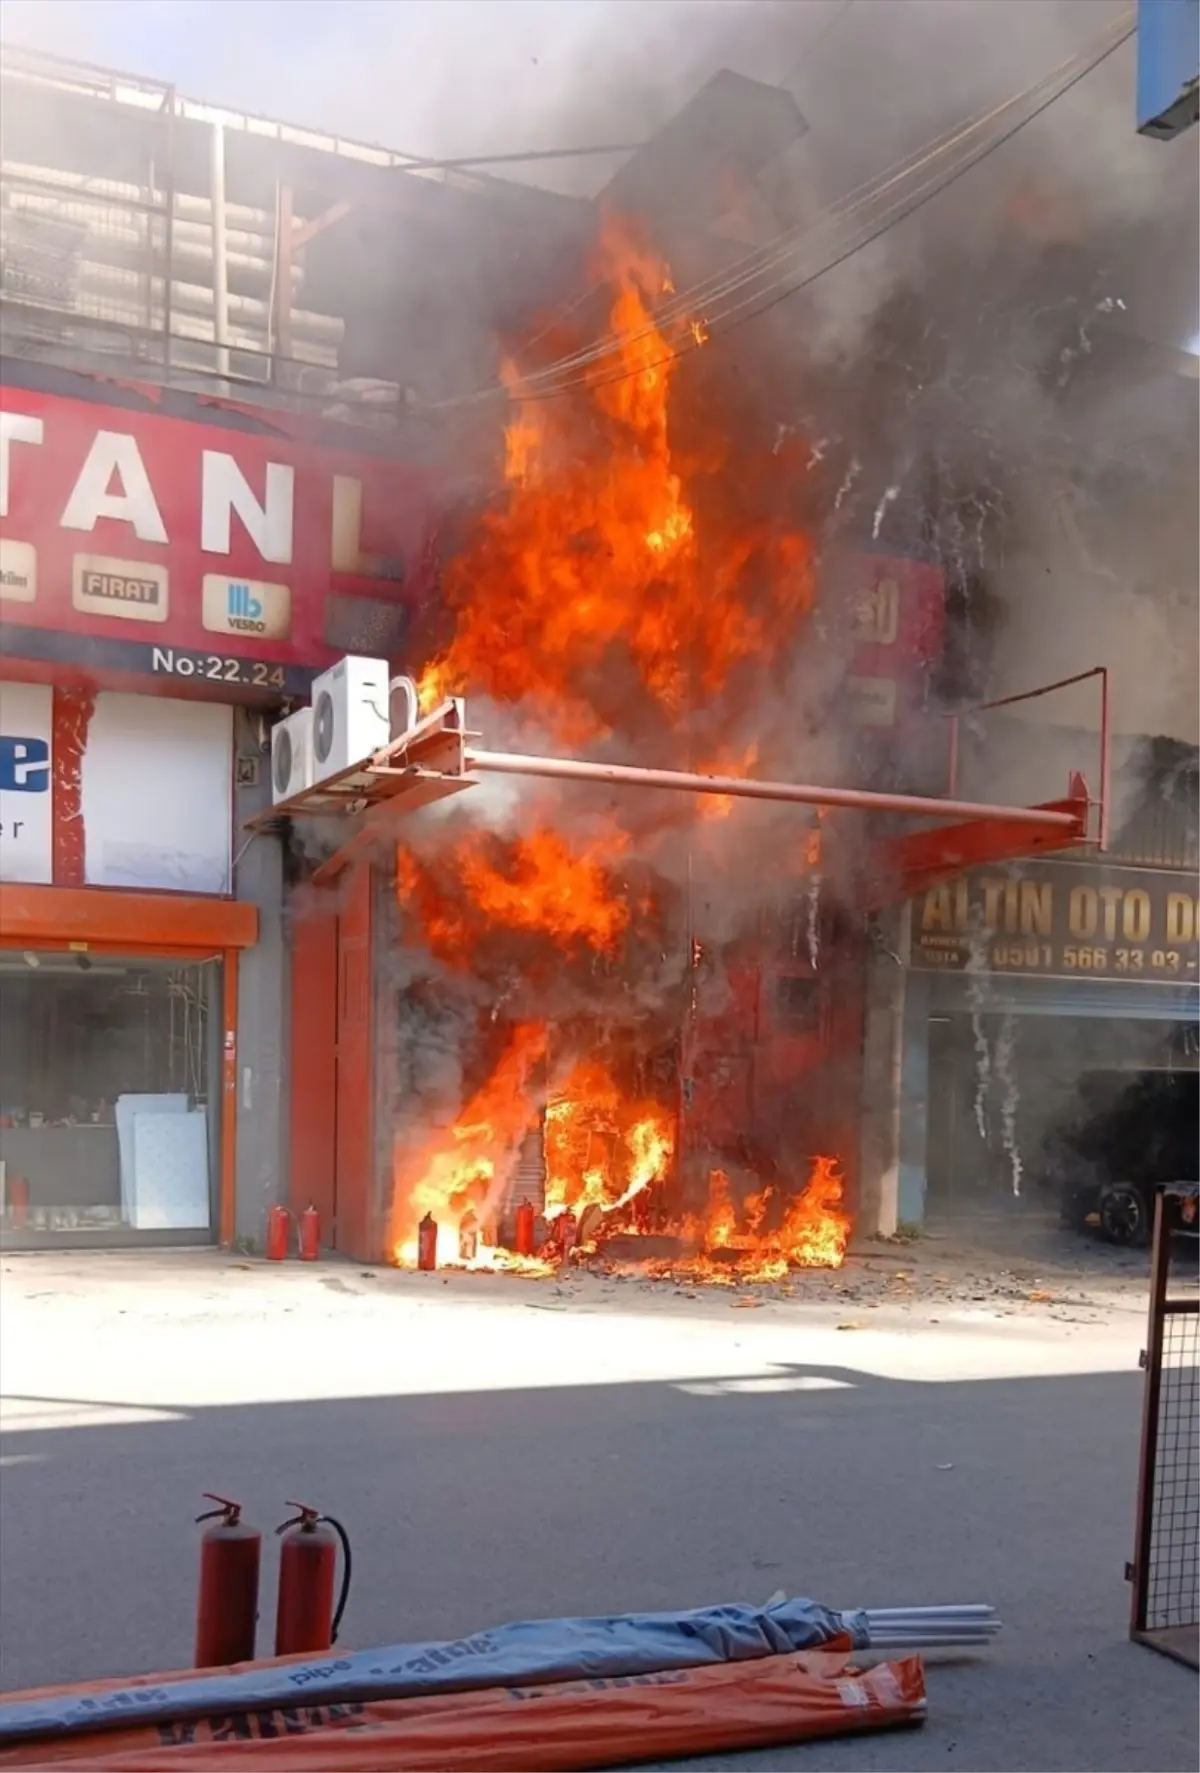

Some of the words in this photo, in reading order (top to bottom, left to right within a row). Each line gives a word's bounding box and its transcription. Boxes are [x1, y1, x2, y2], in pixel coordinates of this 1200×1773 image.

[86, 574, 155, 602] FIRAT
[227, 617, 266, 633] VESBO
[152, 647, 286, 688] No:22.24
[922, 880, 1053, 936] ALTIN
[1069, 886, 1150, 944] OTO
[1167, 892, 1200, 944] D
[1063, 947, 1107, 969] 566
[1115, 949, 1144, 972] 33
[287, 1660, 353, 1686] pipe
